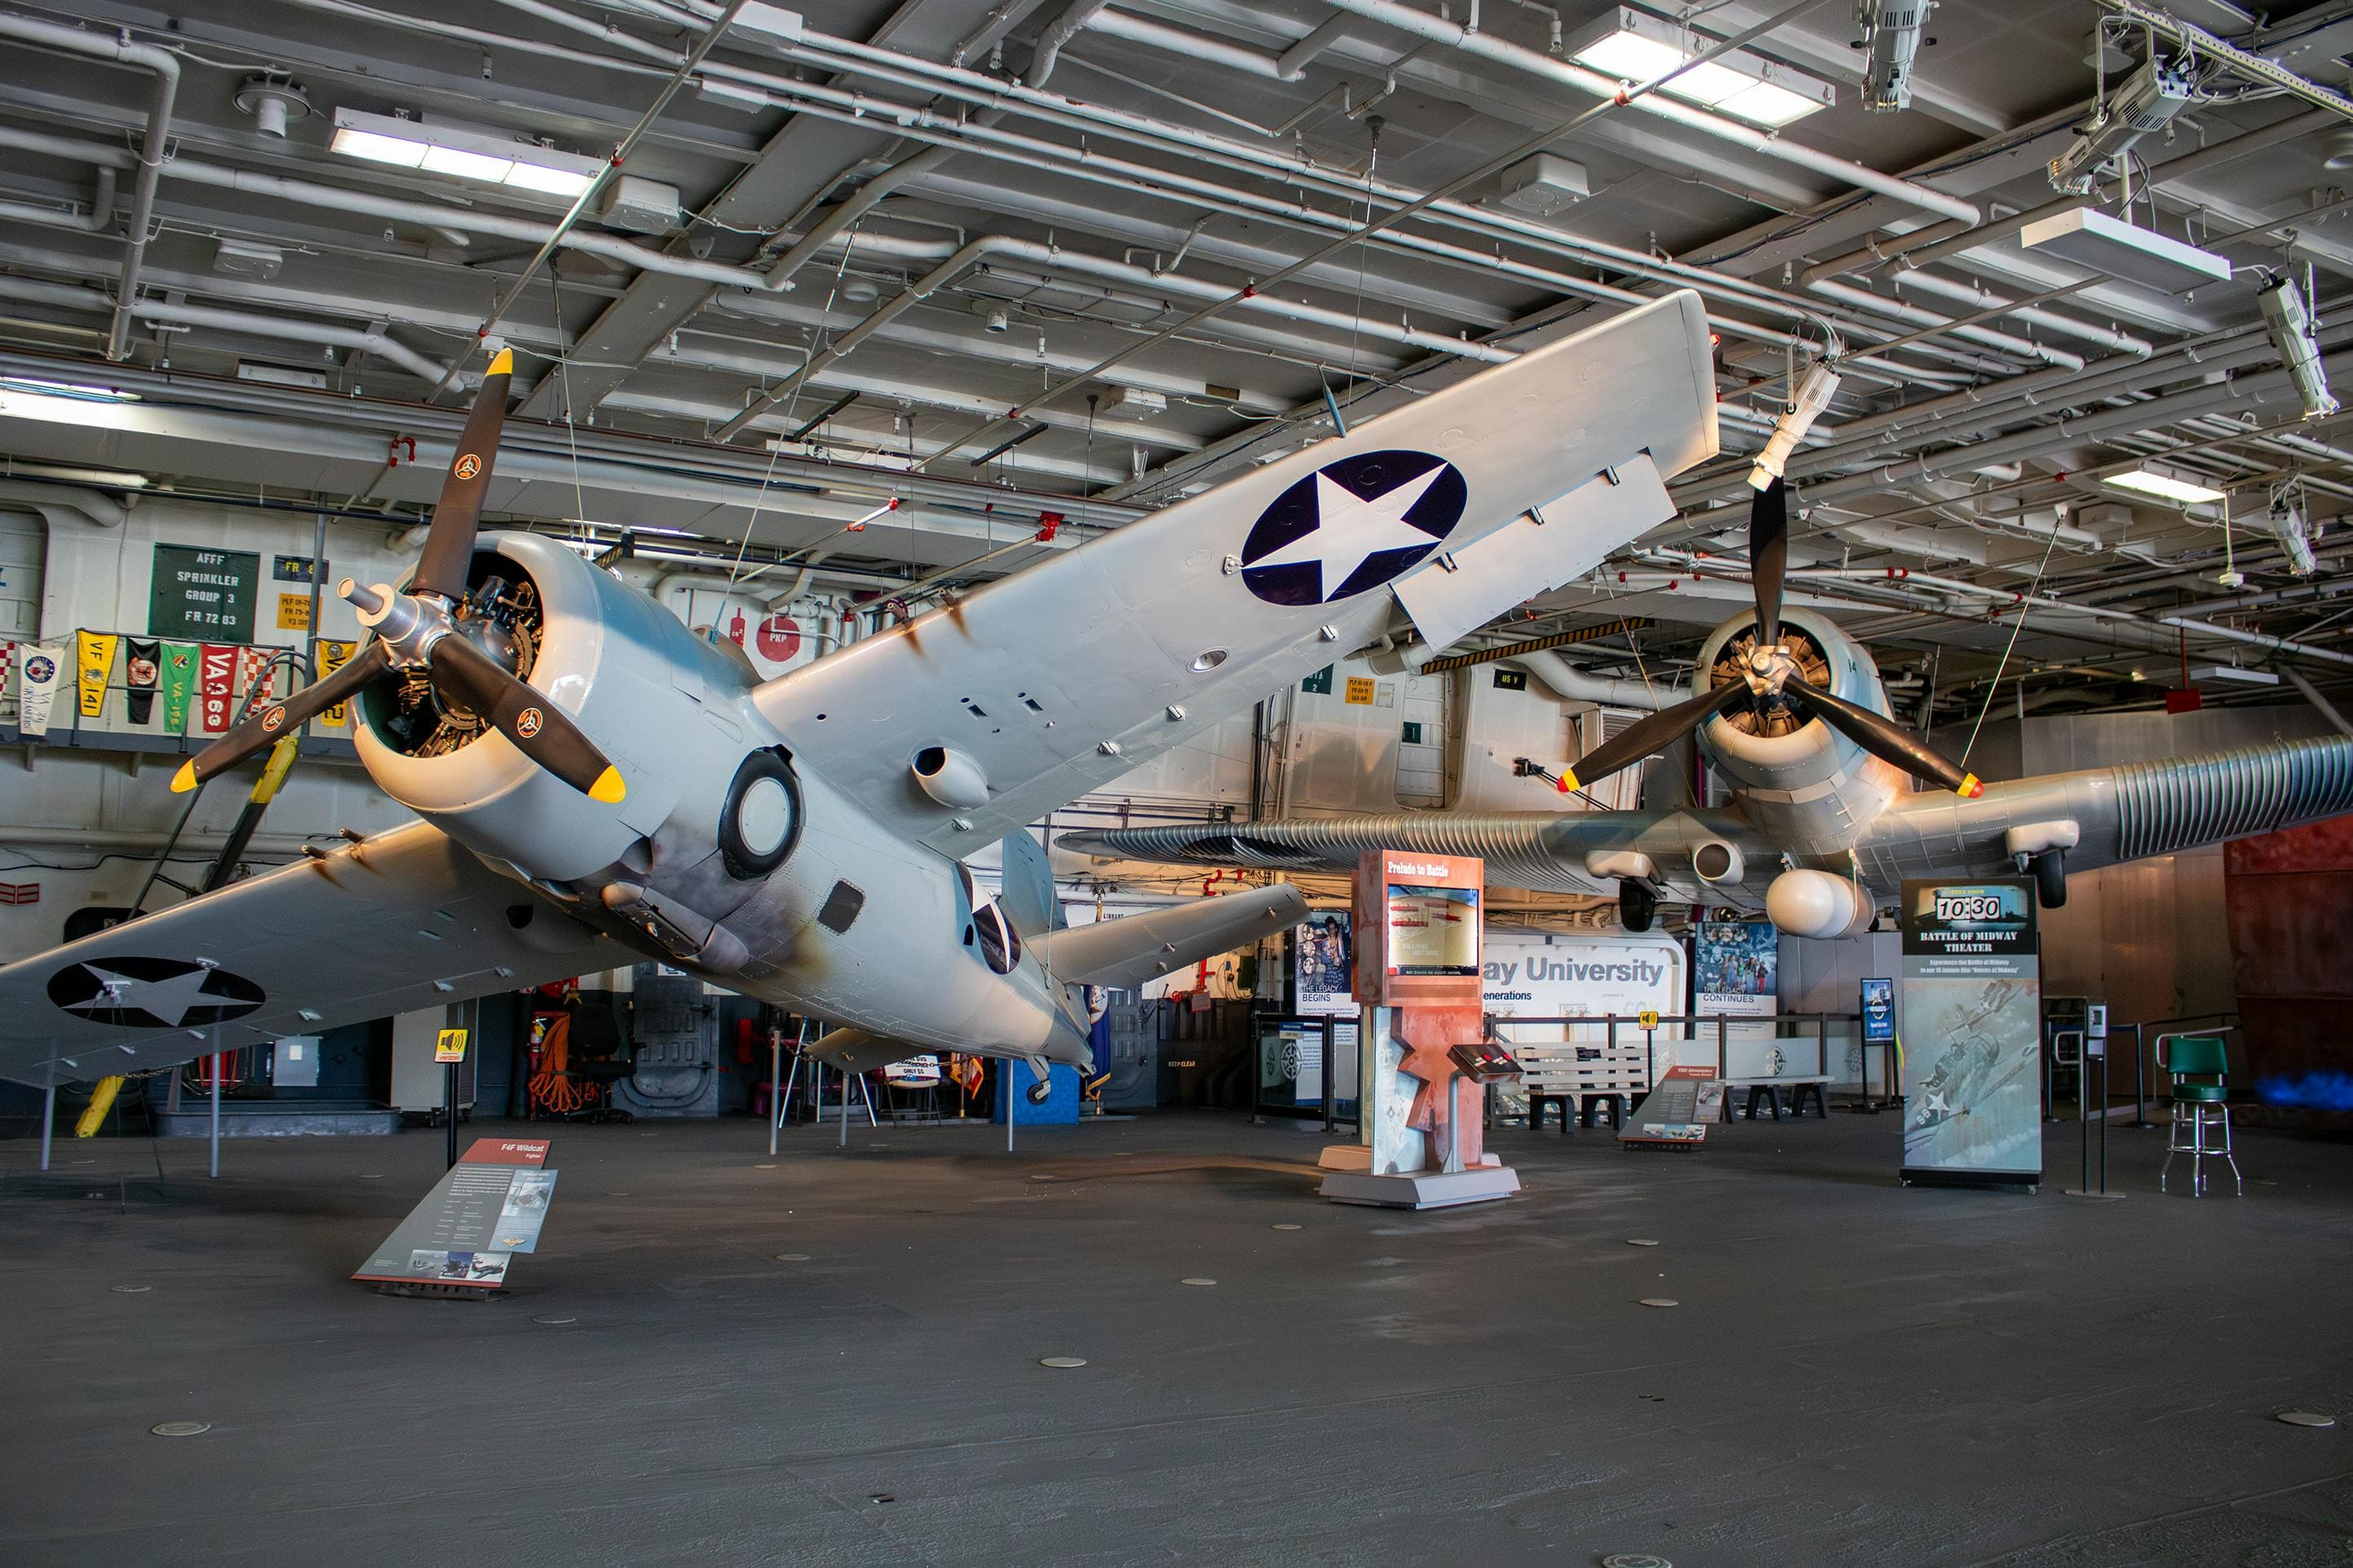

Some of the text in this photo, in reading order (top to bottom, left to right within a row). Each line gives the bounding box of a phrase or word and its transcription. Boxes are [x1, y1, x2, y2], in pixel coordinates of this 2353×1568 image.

[197, 553, 225, 565] AFFF
[285, 561, 299, 572] FR
[177, 572, 239, 586] SPRINKLER
[185, 590, 235, 603] GROUP 3
[185, 611, 201, 621] FR
[206, 613, 219, 624] 72
[770, 633, 787, 643] PKP
[206, 653, 232, 679] VA
[83, 642, 104, 709] VF 141
[1312, 683, 1317, 691] 2
[1387, 861, 1449, 877] Prelude to Battle
[1939, 899, 1998, 917] 10:30
[1920, 931, 2018, 941] BATTLE OF MIDWAY
[1944, 943, 1993, 952] THEATER
[1484, 956, 1664, 987] ay University
[1303, 994, 1331, 1002] BEGINS
[1484, 990, 1532, 1000] enerations
[1703, 995, 1754, 1003] CONTINUES
[516, 1144, 545, 1152] Wildcat
